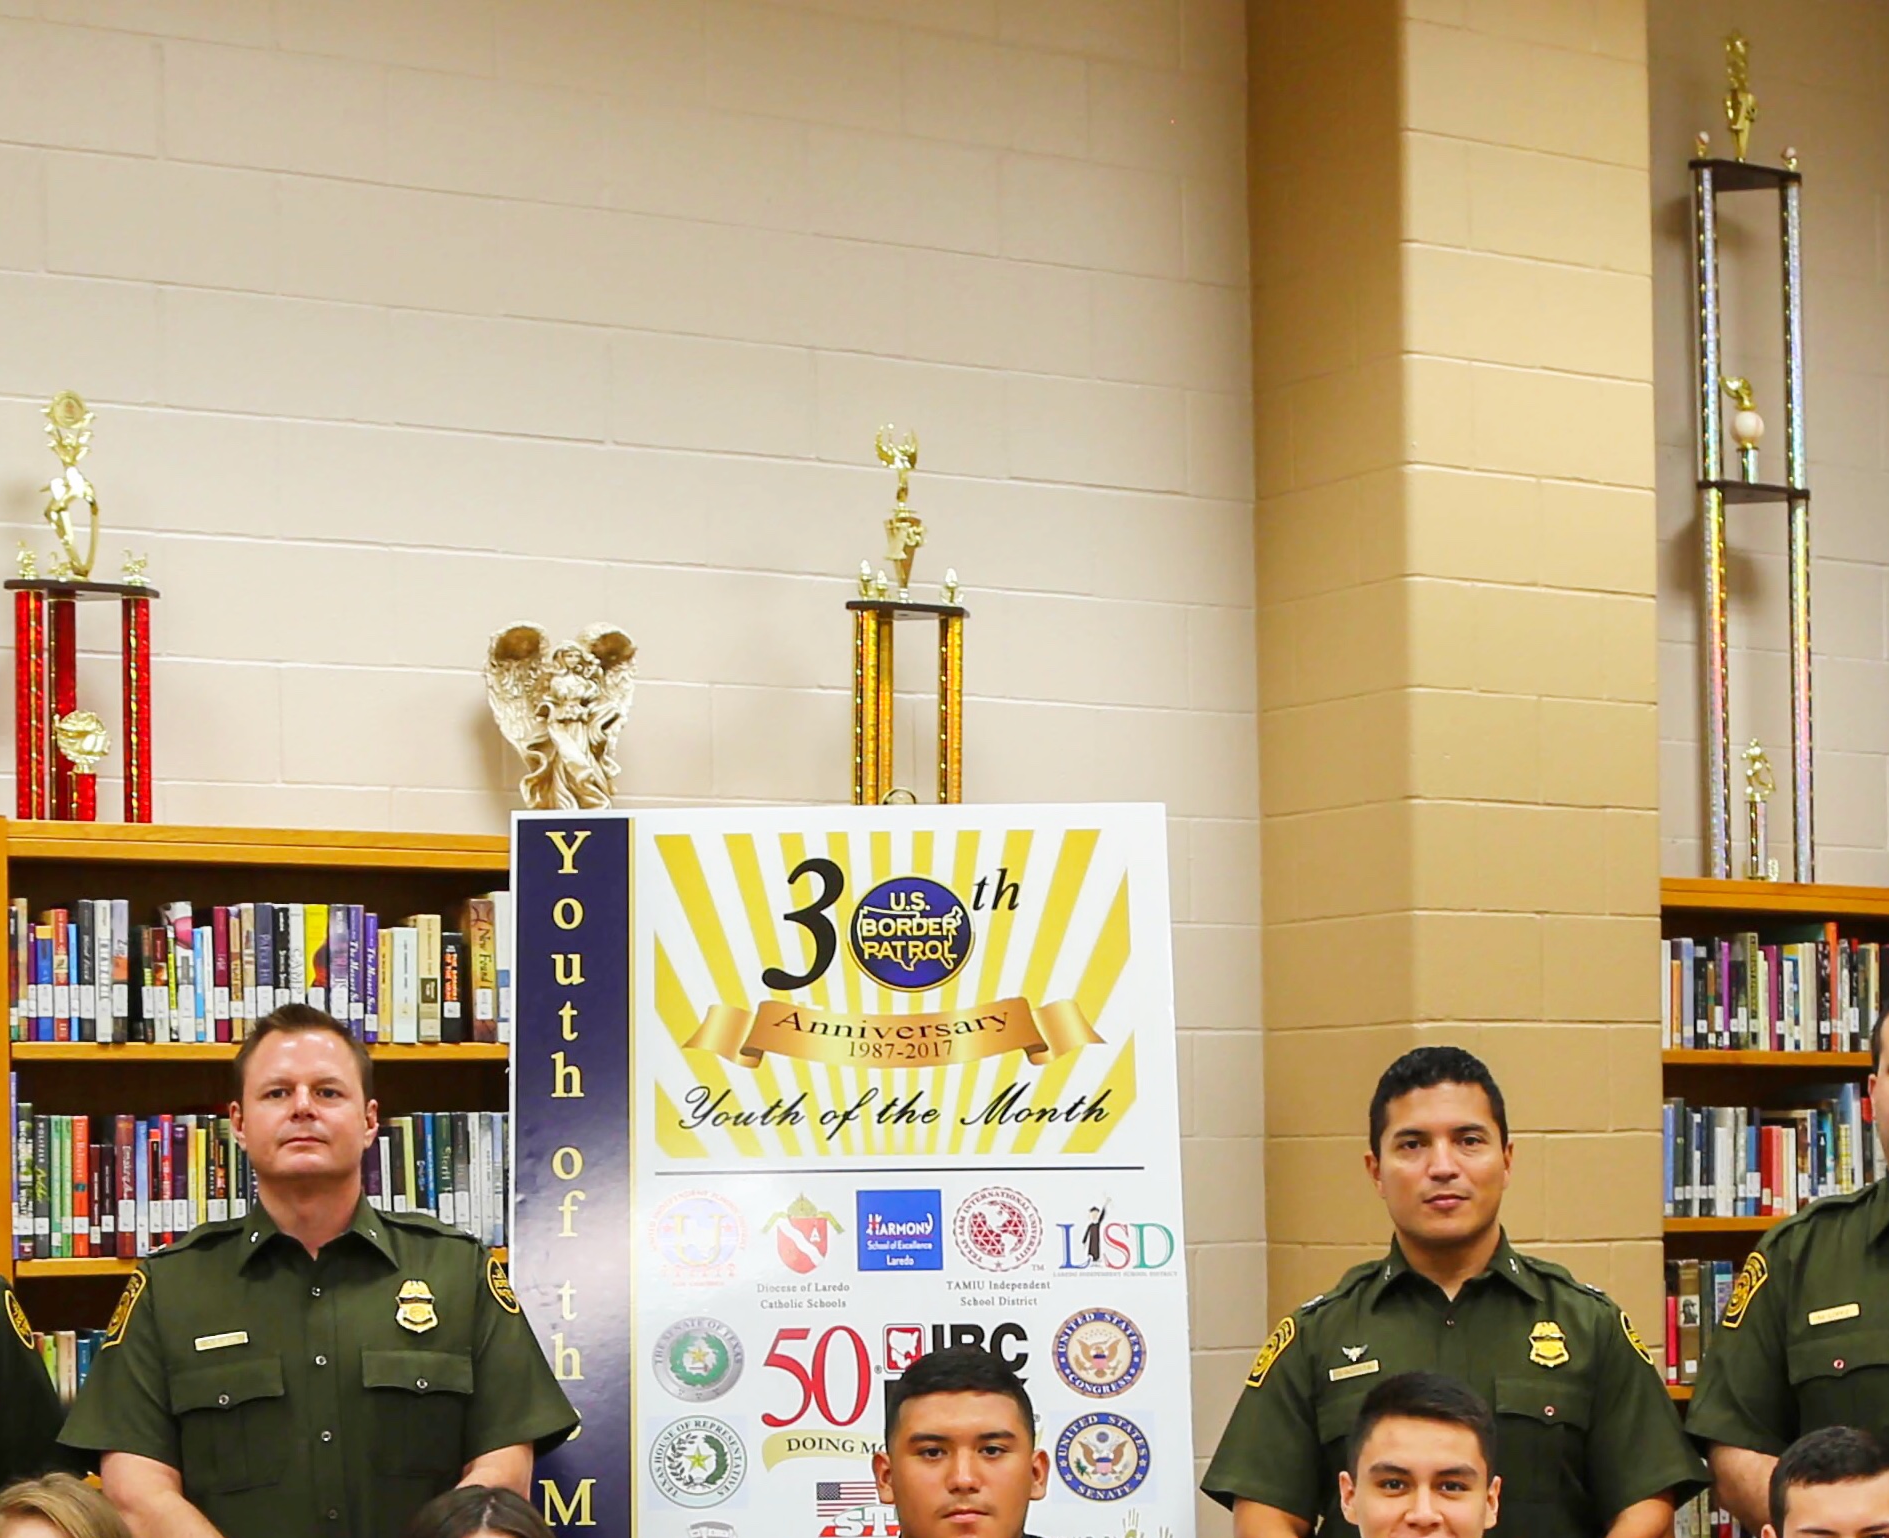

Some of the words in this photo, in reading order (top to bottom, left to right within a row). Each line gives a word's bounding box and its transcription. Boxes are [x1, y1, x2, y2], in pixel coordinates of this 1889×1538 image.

[890, 892, 931, 911] U.S.
[862, 917, 958, 937] BORDER
[477, 928, 491, 951] New
[863, 940, 958, 960] PATROL
[478, 953, 492, 982] Found
[773, 1010, 1009, 1040] Anniversary
[848, 1039, 954, 1060] 1987-2017
[678, 1085, 805, 1131] Youth
[819, 1087, 864, 1141] of
[876, 1091, 940, 1126] the
[959, 1088, 1111, 1127] Month
[38, 1121, 46, 1163] WOLITZER
[865, 1212, 935, 1237] HARMONY
[964, 1191, 1030, 1213] INTERNATIONAL
[1014, 1213, 1038, 1262] UNIVERSITY
[867, 1240, 890, 1251] School
[890, 1240, 897, 1251] of
[897, 1240, 933, 1251] Excellence
[886, 1255, 915, 1267] Laredo
[757, 1283, 798, 1294] Diocese
[800, 1283, 812, 1293] of
[814, 1282, 851, 1293] Laredo
[946, 1280, 985, 1291] TAMIU
[988, 1280, 1051, 1291] Independent
[760, 1299, 804, 1310] Catholic
[806, 1299, 847, 1309] Schools
[960, 1296, 995, 1307] School
[999, 1296, 1038, 1307] District
[1058, 1313, 1096, 1353] UNITED
[1104, 1313, 1141, 1353] STATES
[761, 1325, 872, 1427] 50
[1067, 1373, 1133, 1395] CONGRESS
[676, 1420, 691, 1432] OF
[1058, 1414, 1099, 1457] UNITED
[1107, 1414, 1149, 1457] STATES
[654, 1430, 674, 1464] HOUSE
[787, 1437, 855, 1454] DOING
[694, 1419, 743, 1498] REPRESENTATIVES
[654, 1465, 679, 1499] TEXAS
[1077, 1484, 1133, 1500] SENATE
